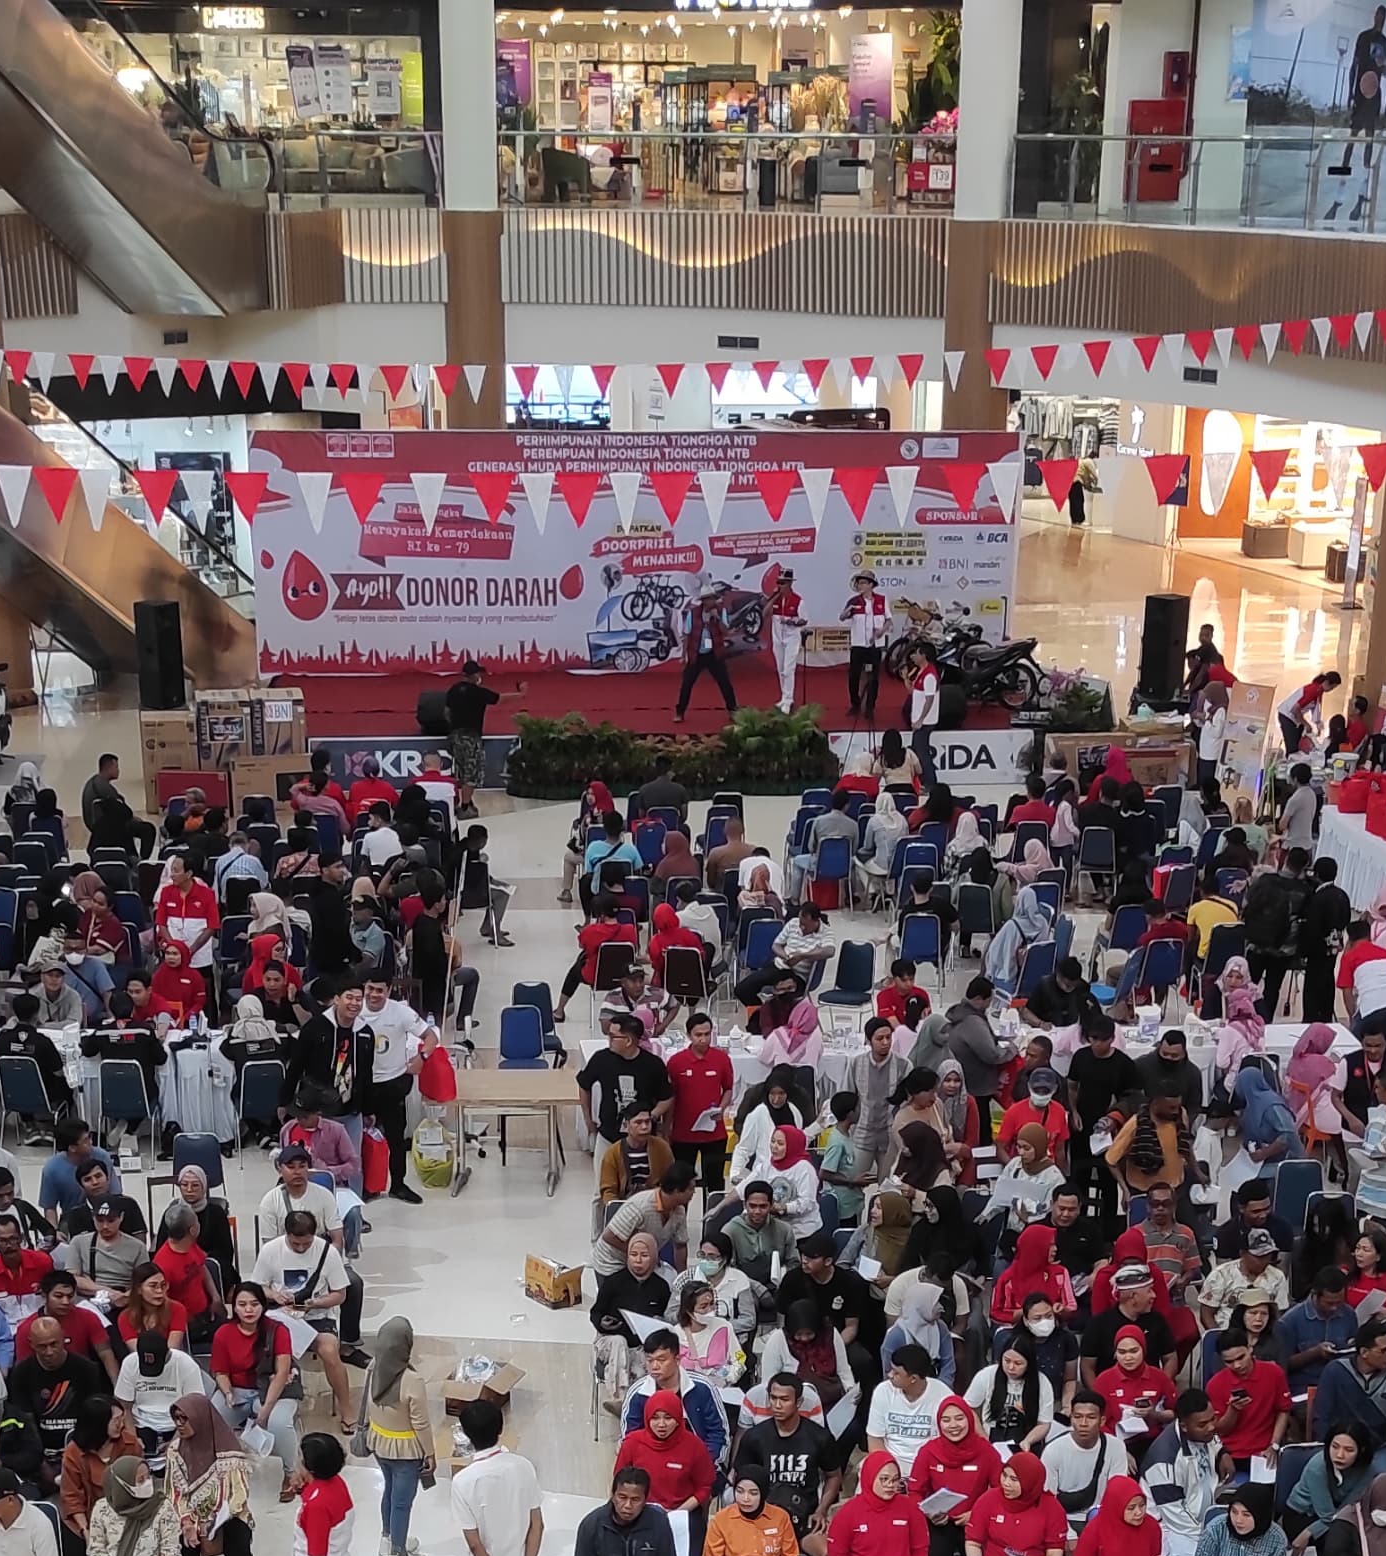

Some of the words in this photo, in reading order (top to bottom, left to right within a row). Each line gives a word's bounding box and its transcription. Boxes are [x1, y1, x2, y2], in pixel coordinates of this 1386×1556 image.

[516, 435, 601, 447] PERHIMPUNAN
[604, 435, 668, 447] INDONESIA
[670, 435, 731, 447] TIONGHOA
[734, 435, 757, 447] NTB
[523, 448, 595, 459] PEREMPUAN
[597, 448, 661, 459] INDONESIA
[663, 448, 725, 459] TIONGHOA
[727, 448, 750, 459] NTB
[468, 461, 525, 473] GENERASI
[528, 461, 563, 473] MUDA
[565, 461, 650, 473] PERHIMPUNAN
[652, 461, 715, 472] INDONESIA
[718, 461, 779, 472] TIONGHOA
[363, 523, 431, 538] Merayakan
[434, 526, 513, 541] Kemerdekaan
[616, 524, 662, 534] DPATKAN
[987, 532, 1008, 543] BCA
[407, 540, 422, 552] RI
[425, 541, 440, 552] ke
[456, 542, 470, 553] 79
[601, 538, 673, 552] DOORPRIZE
[632, 552, 698, 567] MENARIK!!!
[949, 558, 969, 569] BNI
[877, 577, 907, 587] STON
[344, 575, 391, 607] Ayo!!
[406, 577, 479, 607] DONOR
[485, 577, 558, 608] DARAH
[274, 703, 292, 719] BNI
[890, 1413, 929, 1425] ORIGINAL
